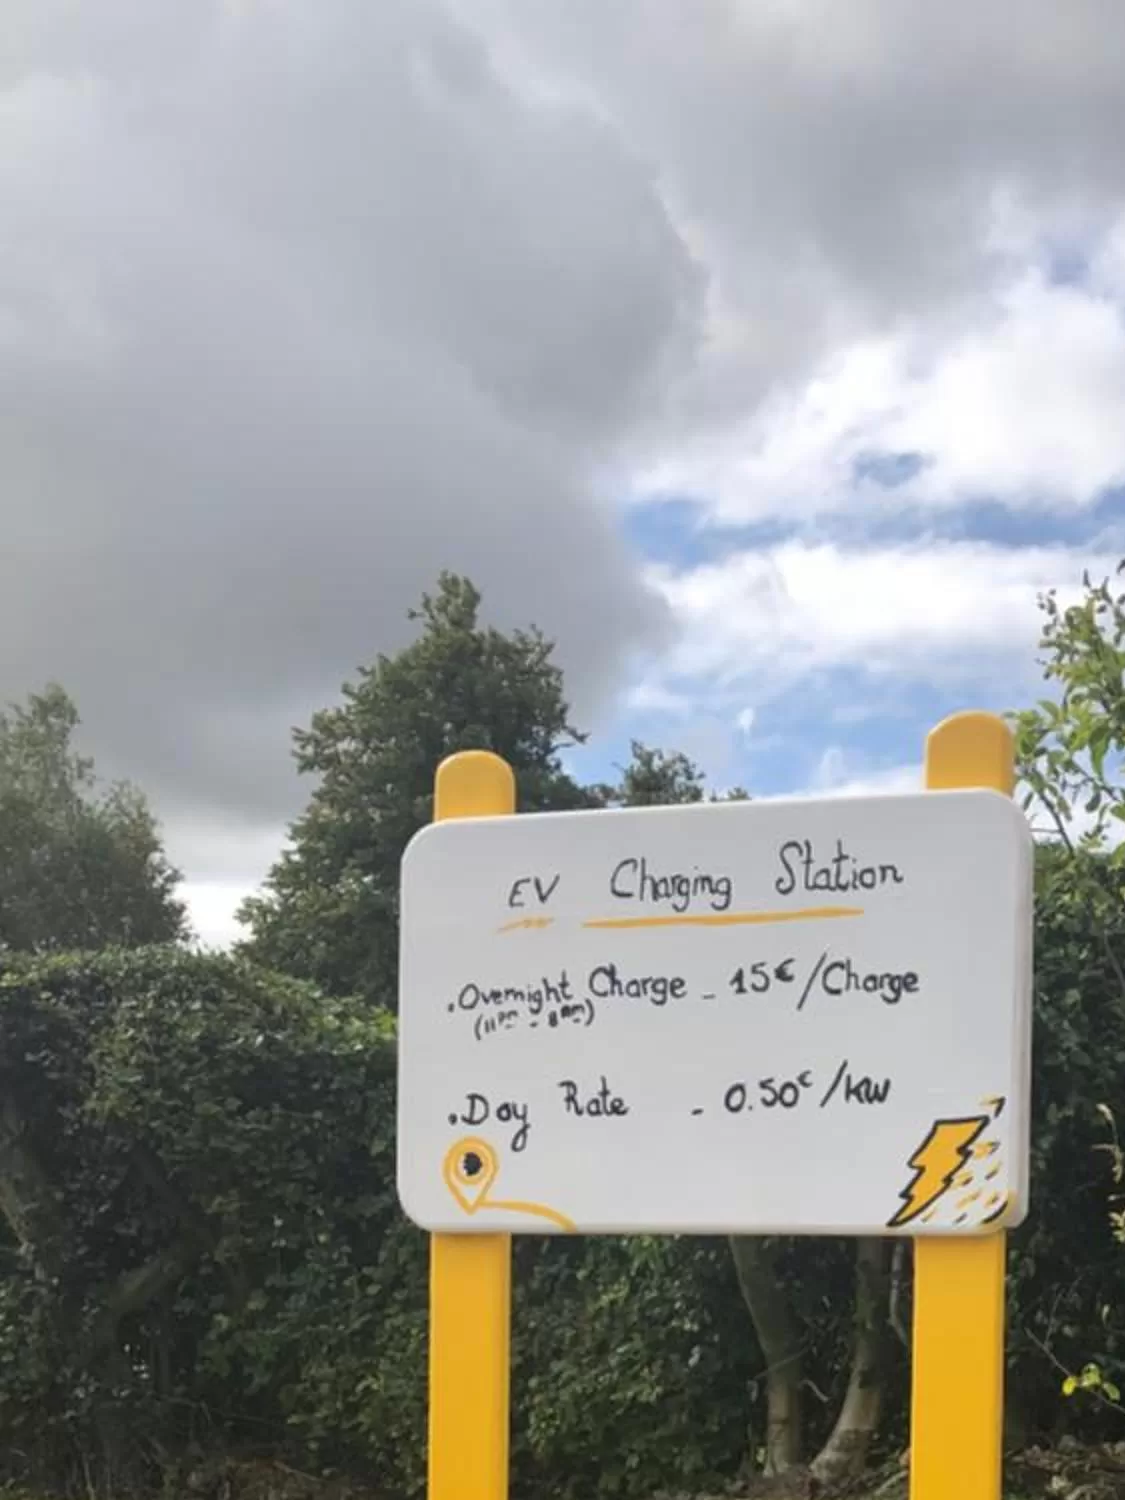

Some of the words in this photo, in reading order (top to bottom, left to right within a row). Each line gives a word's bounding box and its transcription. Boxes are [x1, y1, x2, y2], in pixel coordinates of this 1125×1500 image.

[507, 874, 561, 908] EV
[610, 857, 733, 912] Charging
[775, 839, 904, 896] Station
[588, 963, 689, 1006] Charge
[557, 1075, 632, 1117] Rate
